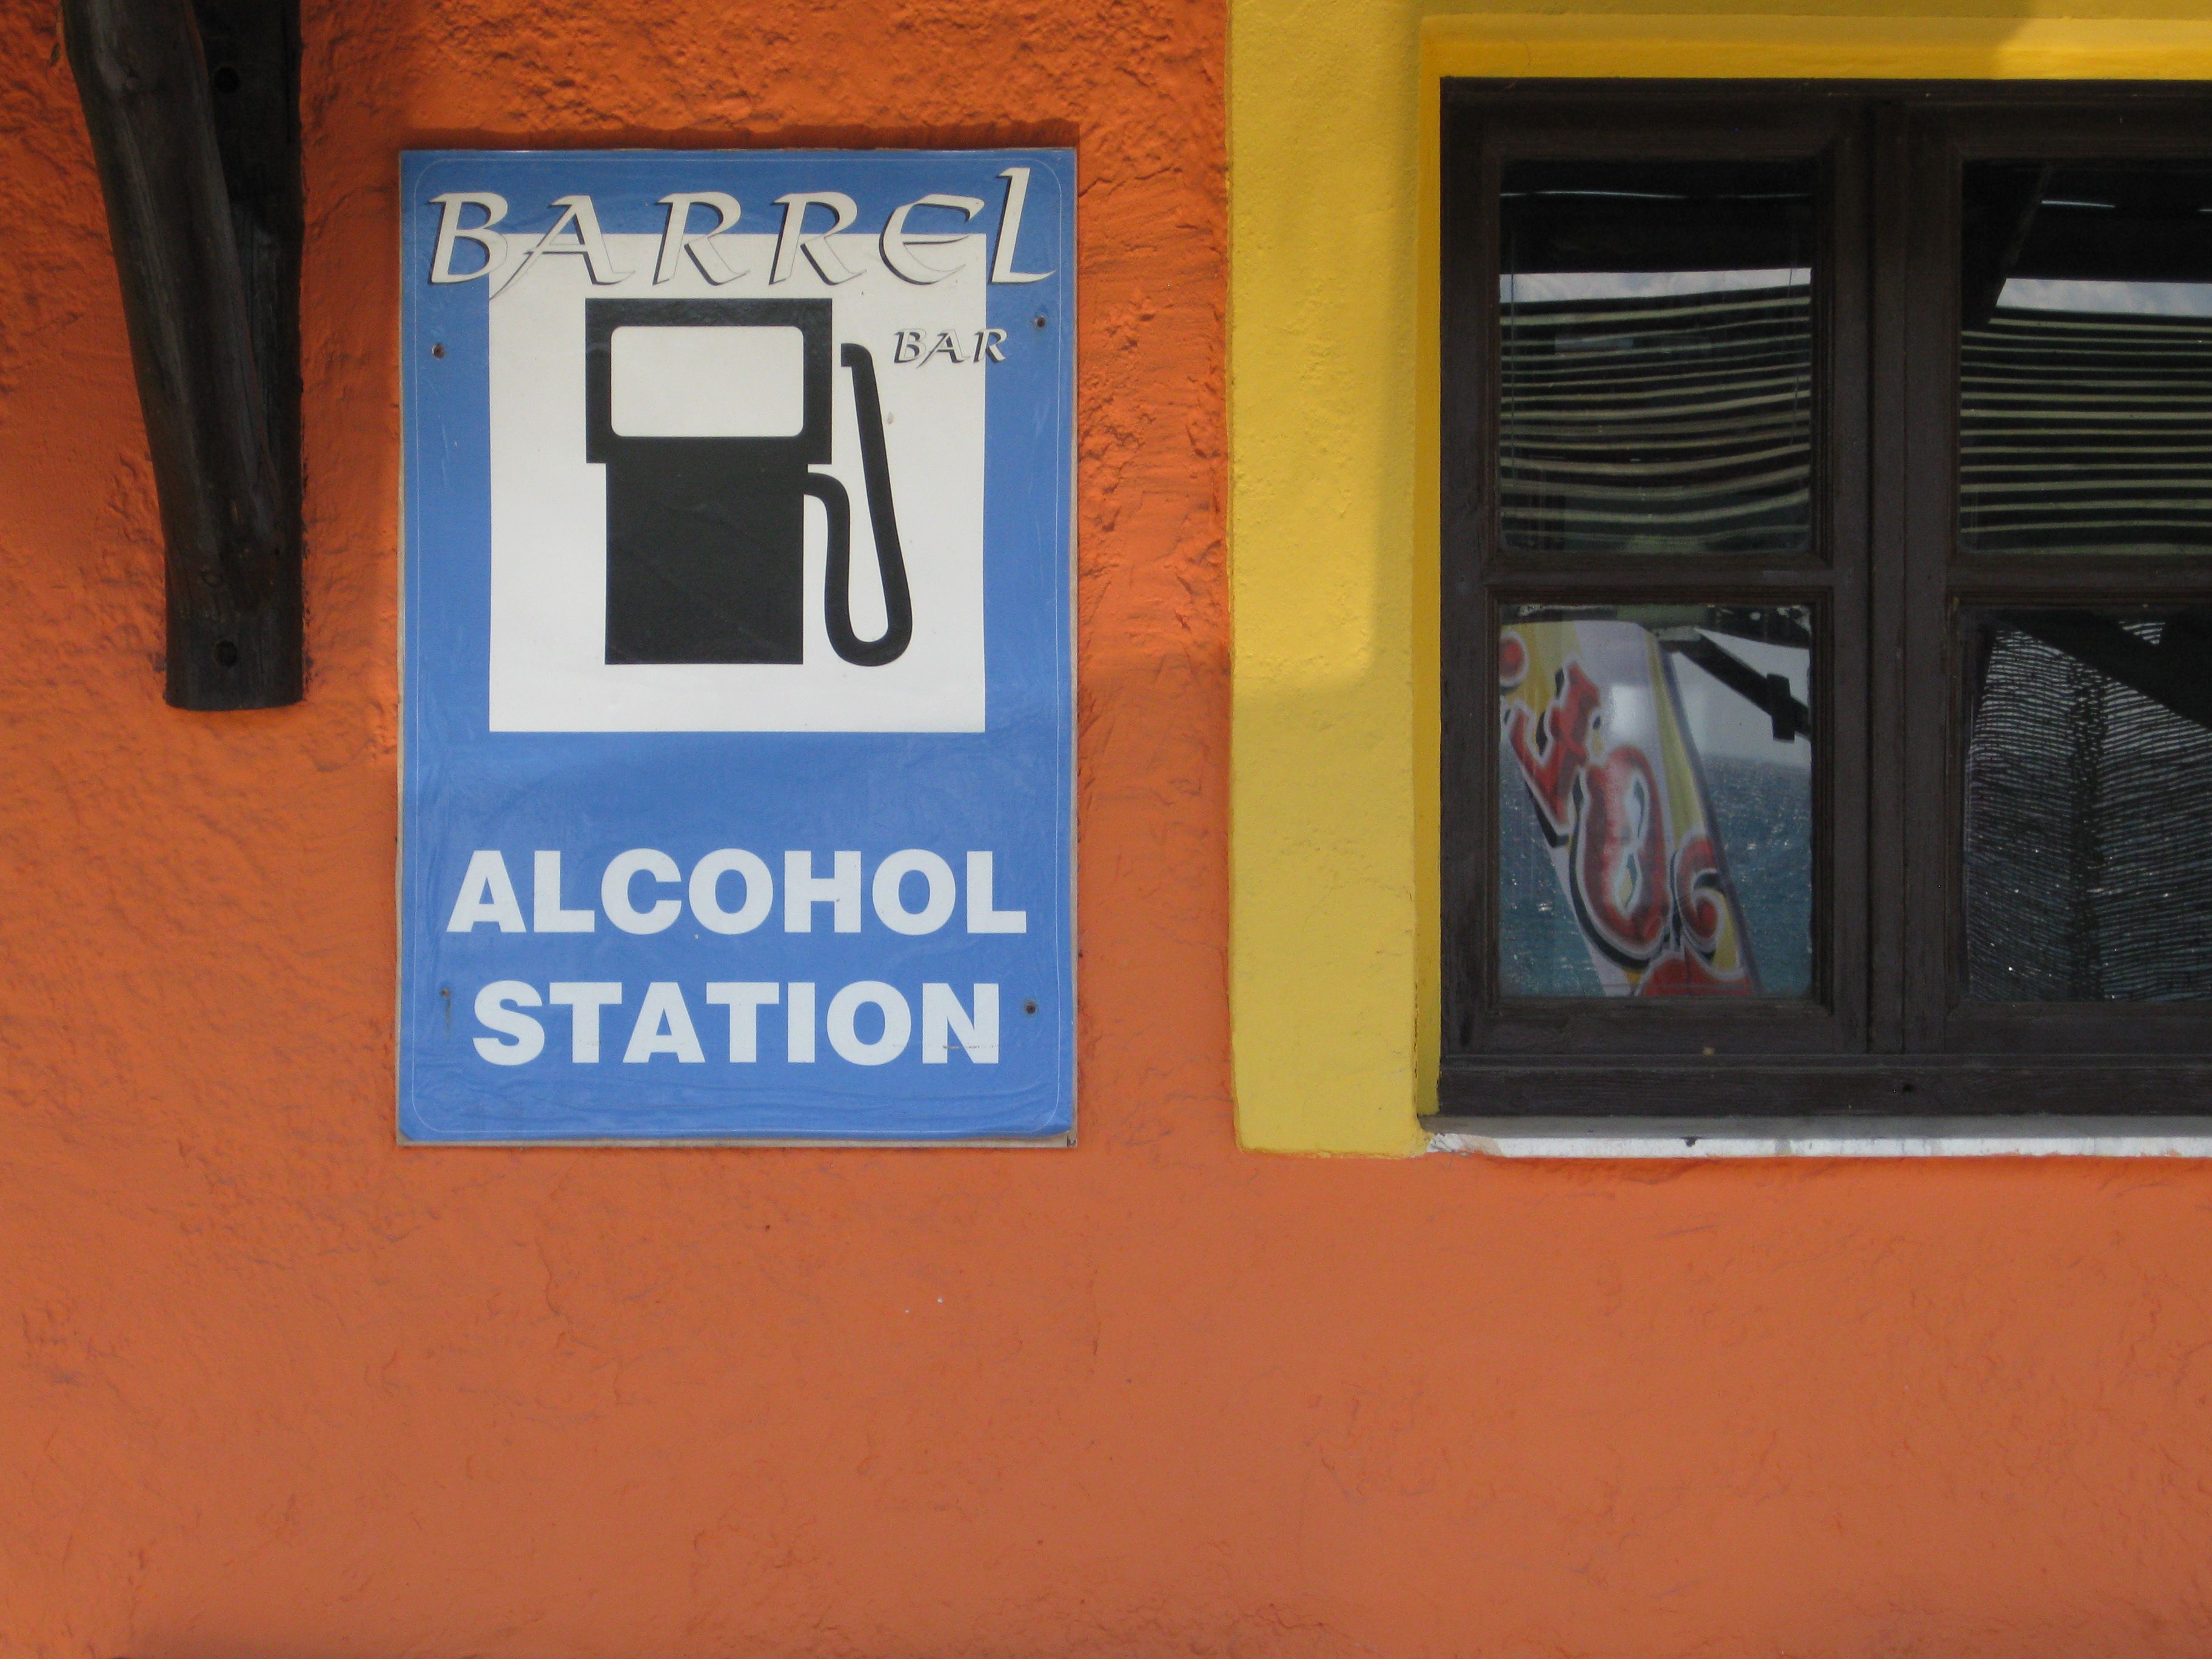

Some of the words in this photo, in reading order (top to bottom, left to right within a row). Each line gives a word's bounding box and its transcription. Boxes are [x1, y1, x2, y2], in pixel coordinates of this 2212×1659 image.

[427, 167, 1057, 298] BARREL
[893, 327, 1008, 367] BAR
[446, 848, 1027, 936] ALCOHOL
[472, 980, 1000, 1066] STATION
